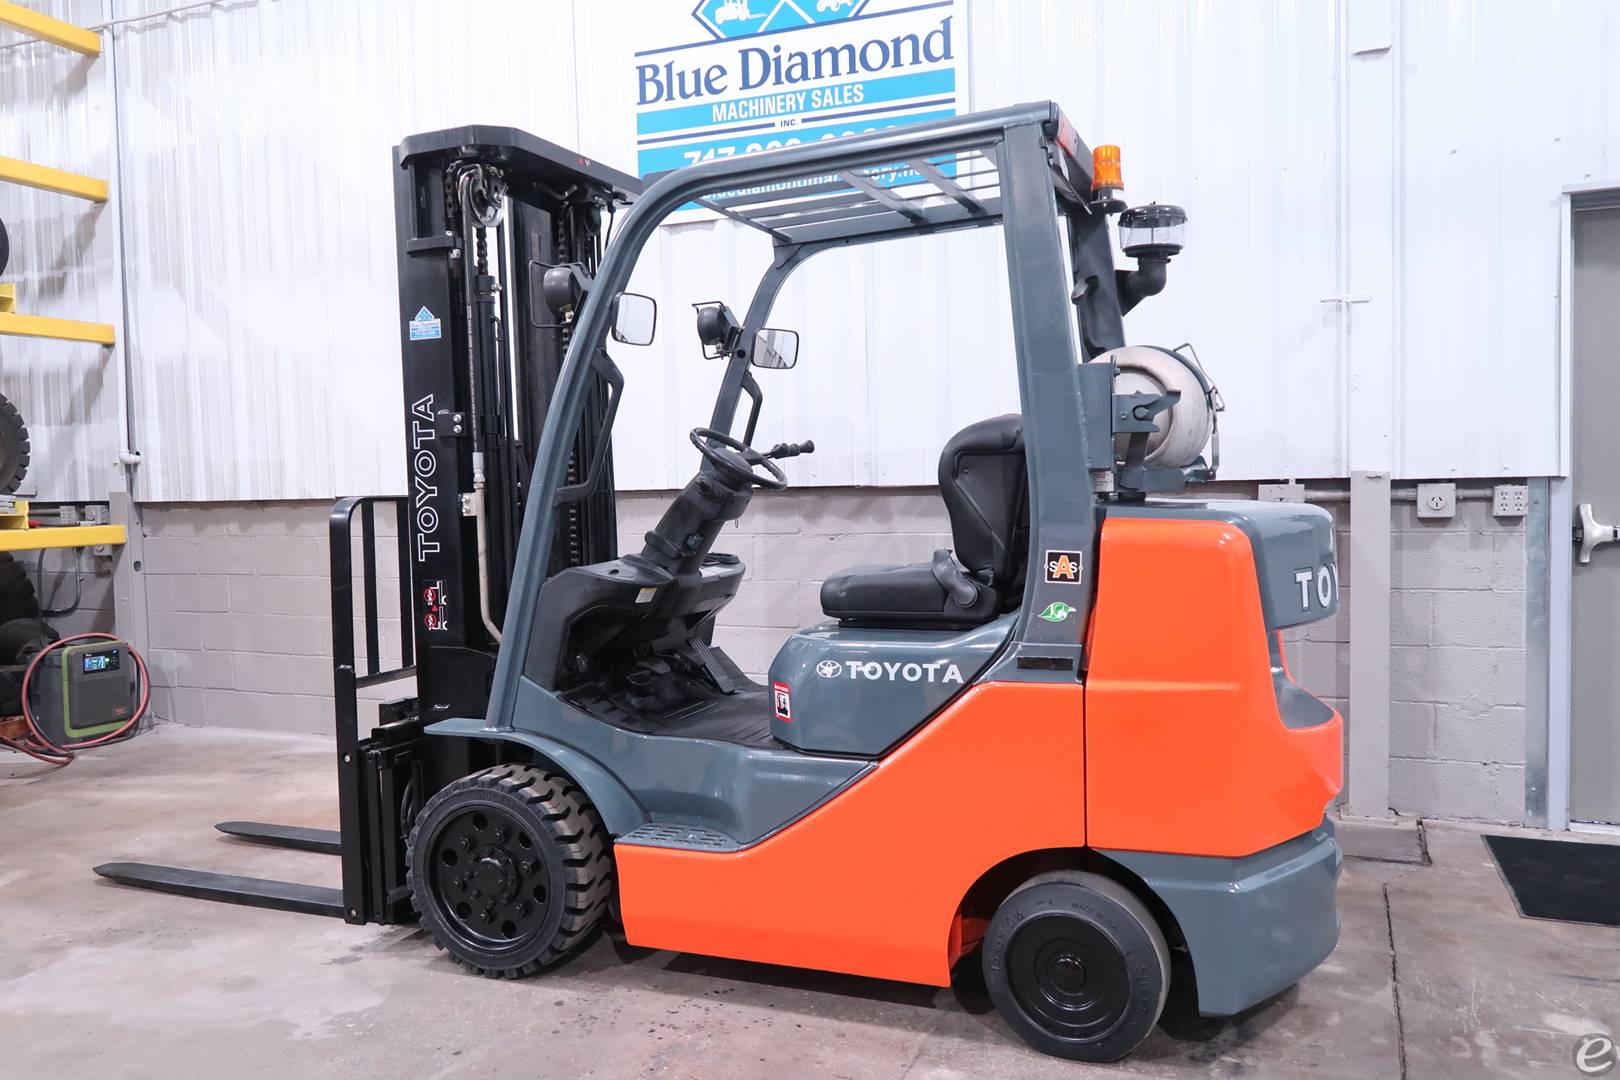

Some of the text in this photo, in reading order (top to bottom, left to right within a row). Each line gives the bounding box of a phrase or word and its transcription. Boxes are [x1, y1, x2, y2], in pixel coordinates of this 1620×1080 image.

[636, 15, 954, 105] Blue Diamond
[712, 83, 864, 123] MACHINERY SALES
[780, 119, 799, 128] INC.
[412, 394, 440, 562] TOYOTA
[846, 660, 963, 684] TOYOTA
